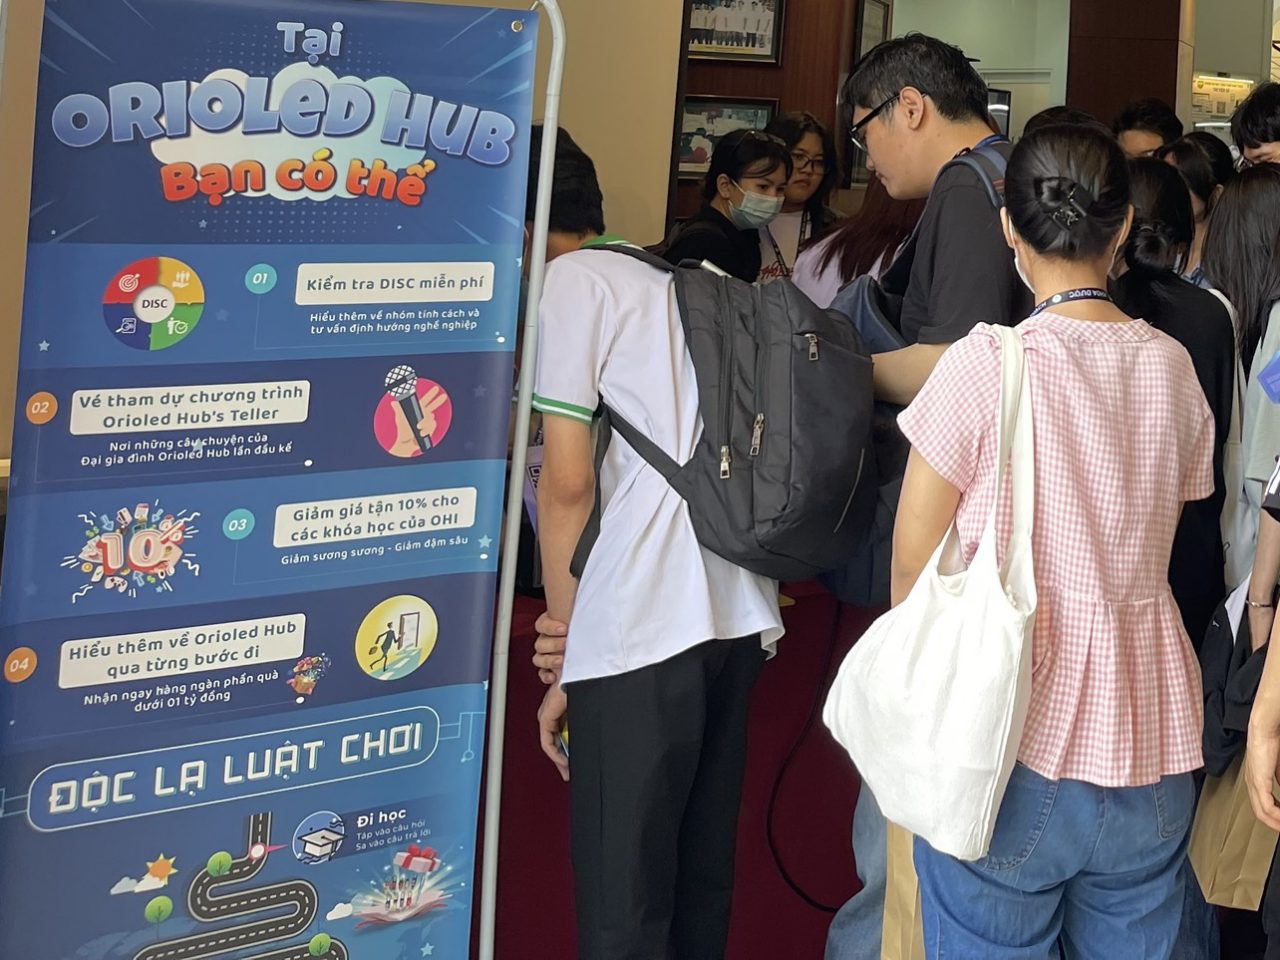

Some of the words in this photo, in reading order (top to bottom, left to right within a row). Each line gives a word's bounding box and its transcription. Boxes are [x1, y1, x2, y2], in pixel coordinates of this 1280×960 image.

[276, 20, 345, 65] Tại
[380, 89, 517, 167] HUB
[160, 158, 265, 206] Bạn
[275, 147, 338, 192] có
[346, 157, 438, 207] thể
[252, 273, 267, 284] 01
[307, 274, 347, 291] Kiểm
[352, 279, 375, 290] tra
[380, 278, 415, 289] DISC
[419, 273, 455, 289] miễn
[460, 275, 485, 292] phí
[142, 299, 168, 309] DISC
[339, 310, 367, 321] thêm
[385, 309, 415, 320] nhóm
[418, 308, 439, 319] tính
[441, 308, 465, 319] cách
[467, 308, 480, 318] và
[311, 325, 324, 334] tư
[327, 323, 346, 334] vấn
[349, 321, 374, 335] định
[376, 320, 411, 334] hướng
[441, 320, 477, 332] nghiệp
[79, 394, 101, 408] Vé
[107, 394, 153, 407] tham
[160, 391, 183, 408] dự
[190, 390, 255, 404] chương
[261, 386, 303, 400] trình
[31, 402, 49, 414] 02
[103, 413, 171, 428] Orioled
[176, 410, 224, 424] Hub's
[230, 408, 279, 421] Teller
[110, 439, 132, 452] Nơi
[134, 438, 174, 452] những
[177, 436, 199, 448] câu
[202, 434, 245, 448] chuyện
[247, 432, 268, 443] của
[80, 454, 102, 467] Đại
[104, 453, 125, 467] gia
[127, 450, 155, 463] đình
[158, 448, 203, 462] Orioled
[206, 446, 230, 458] Hub
[293, 508, 334, 522] Giảm
[339, 504, 363, 519] giá
[368, 501, 393, 517] tận
[399, 497, 427, 511] 10%
[432, 494, 460, 506] cho
[228, 518, 247, 532] 03
[291, 528, 318, 542] các
[323, 523, 362, 538] khóa
[367, 520, 395, 536] học
[399, 516, 426, 530] của
[430, 513, 458, 526] OHI
[96, 514, 187, 576] 10%
[281, 552, 310, 565] Giảm
[313, 549, 348, 562] sương
[351, 546, 384, 558] sương
[395, 539, 421, 552] Giảm
[424, 537, 447, 549] đậm
[449, 535, 469, 546] sâu
[69, 641, 111, 660] Hiểu
[117, 637, 163, 655] thêm
[169, 631, 190, 649] về
[195, 625, 258, 645] Orioled
[264, 622, 297, 637] Hub
[9, 657, 29, 671] 04
[107, 663, 140, 679] qua
[146, 654, 189, 673] từng
[195, 649, 239, 666] bước
[244, 645, 260, 659] đi
[83, 691, 118, 707] Nhận
[121, 688, 152, 703] ngay
[156, 682, 187, 698] hàng
[190, 679, 221, 694] ngàn
[257, 670, 279, 684] quà
[134, 698, 164, 713] dưới
[167, 697, 181, 708] 01
[184, 692, 197, 707] tỷ
[48, 770, 137, 814] ĐỘC
[154, 759, 207, 797] LẠ
[223, 739, 326, 785] LUẬT
[340, 722, 423, 765] CHƠI
[356, 813, 373, 828] Đi
[379, 809, 406, 823] học
[375, 827, 391, 836] vào
[392, 824, 409, 832] câu
[369, 839, 384, 847] vào
[387, 835, 403, 844] câu
